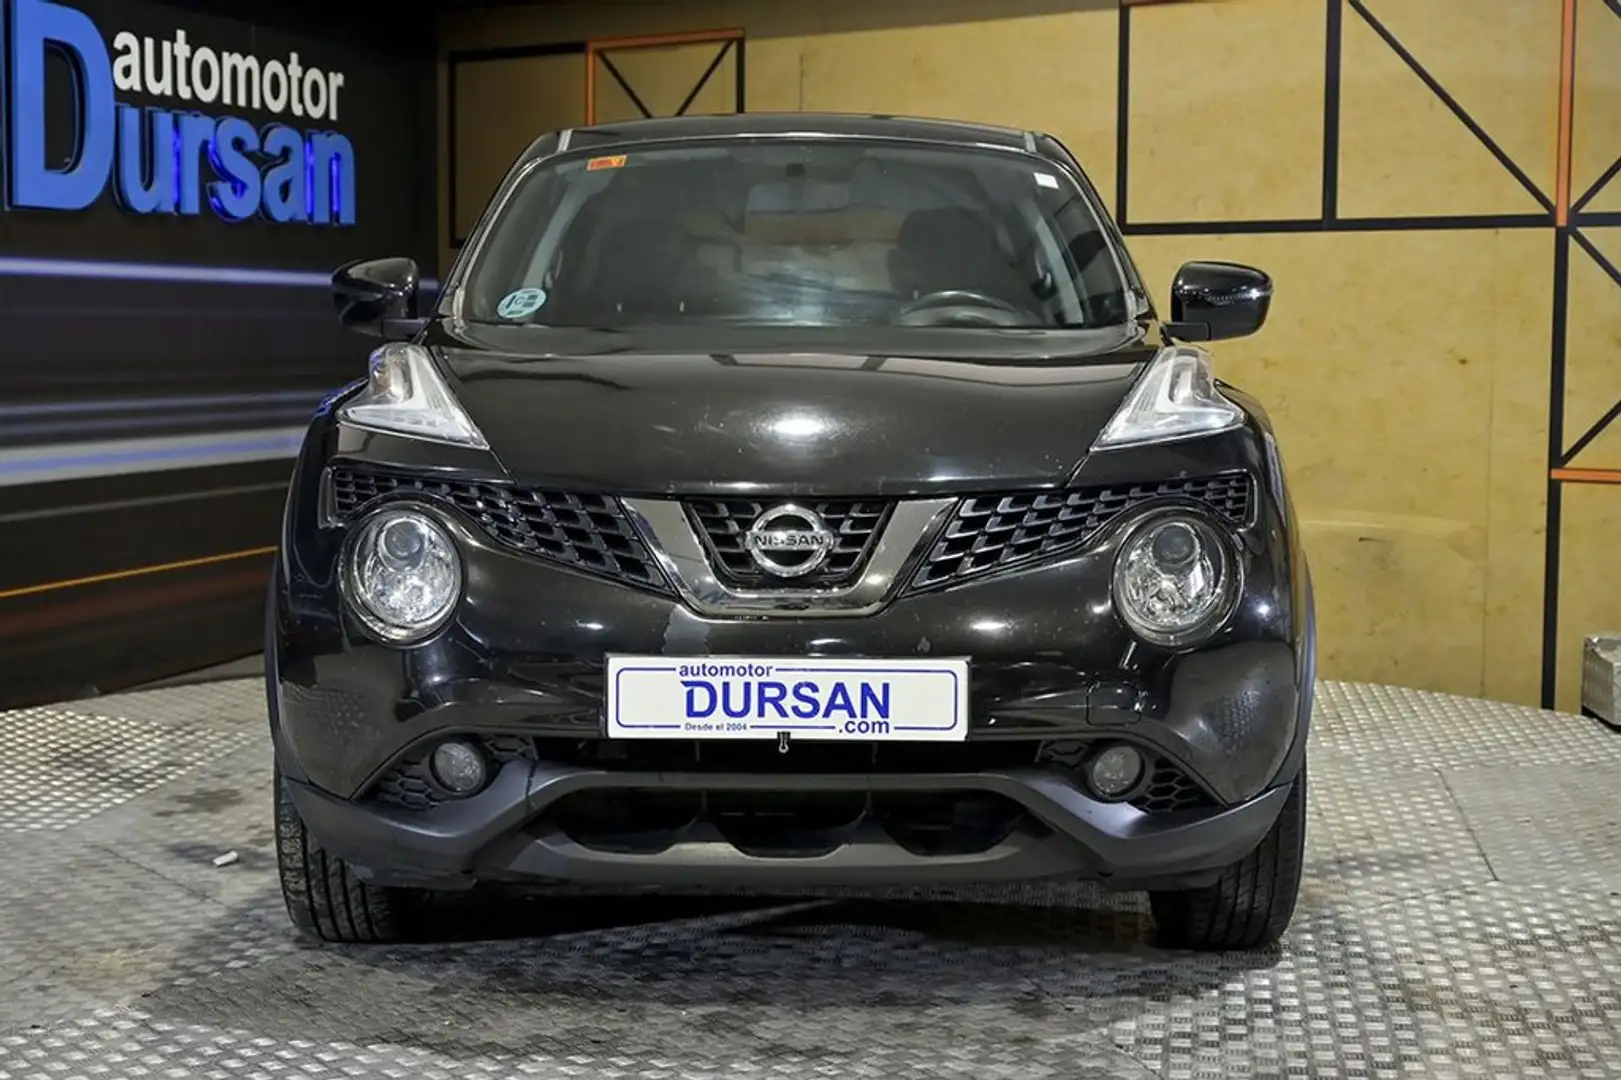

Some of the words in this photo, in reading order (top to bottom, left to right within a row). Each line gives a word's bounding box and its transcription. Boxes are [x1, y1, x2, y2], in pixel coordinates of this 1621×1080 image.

[112, 29, 345, 121] automotor
[3, 0, 356, 226] Dursan
[679, 663, 773, 677] automotor
[680, 681, 890, 718] DURSAN
[685, 723, 713, 731] Desde
[839, 720, 890, 734] .com
